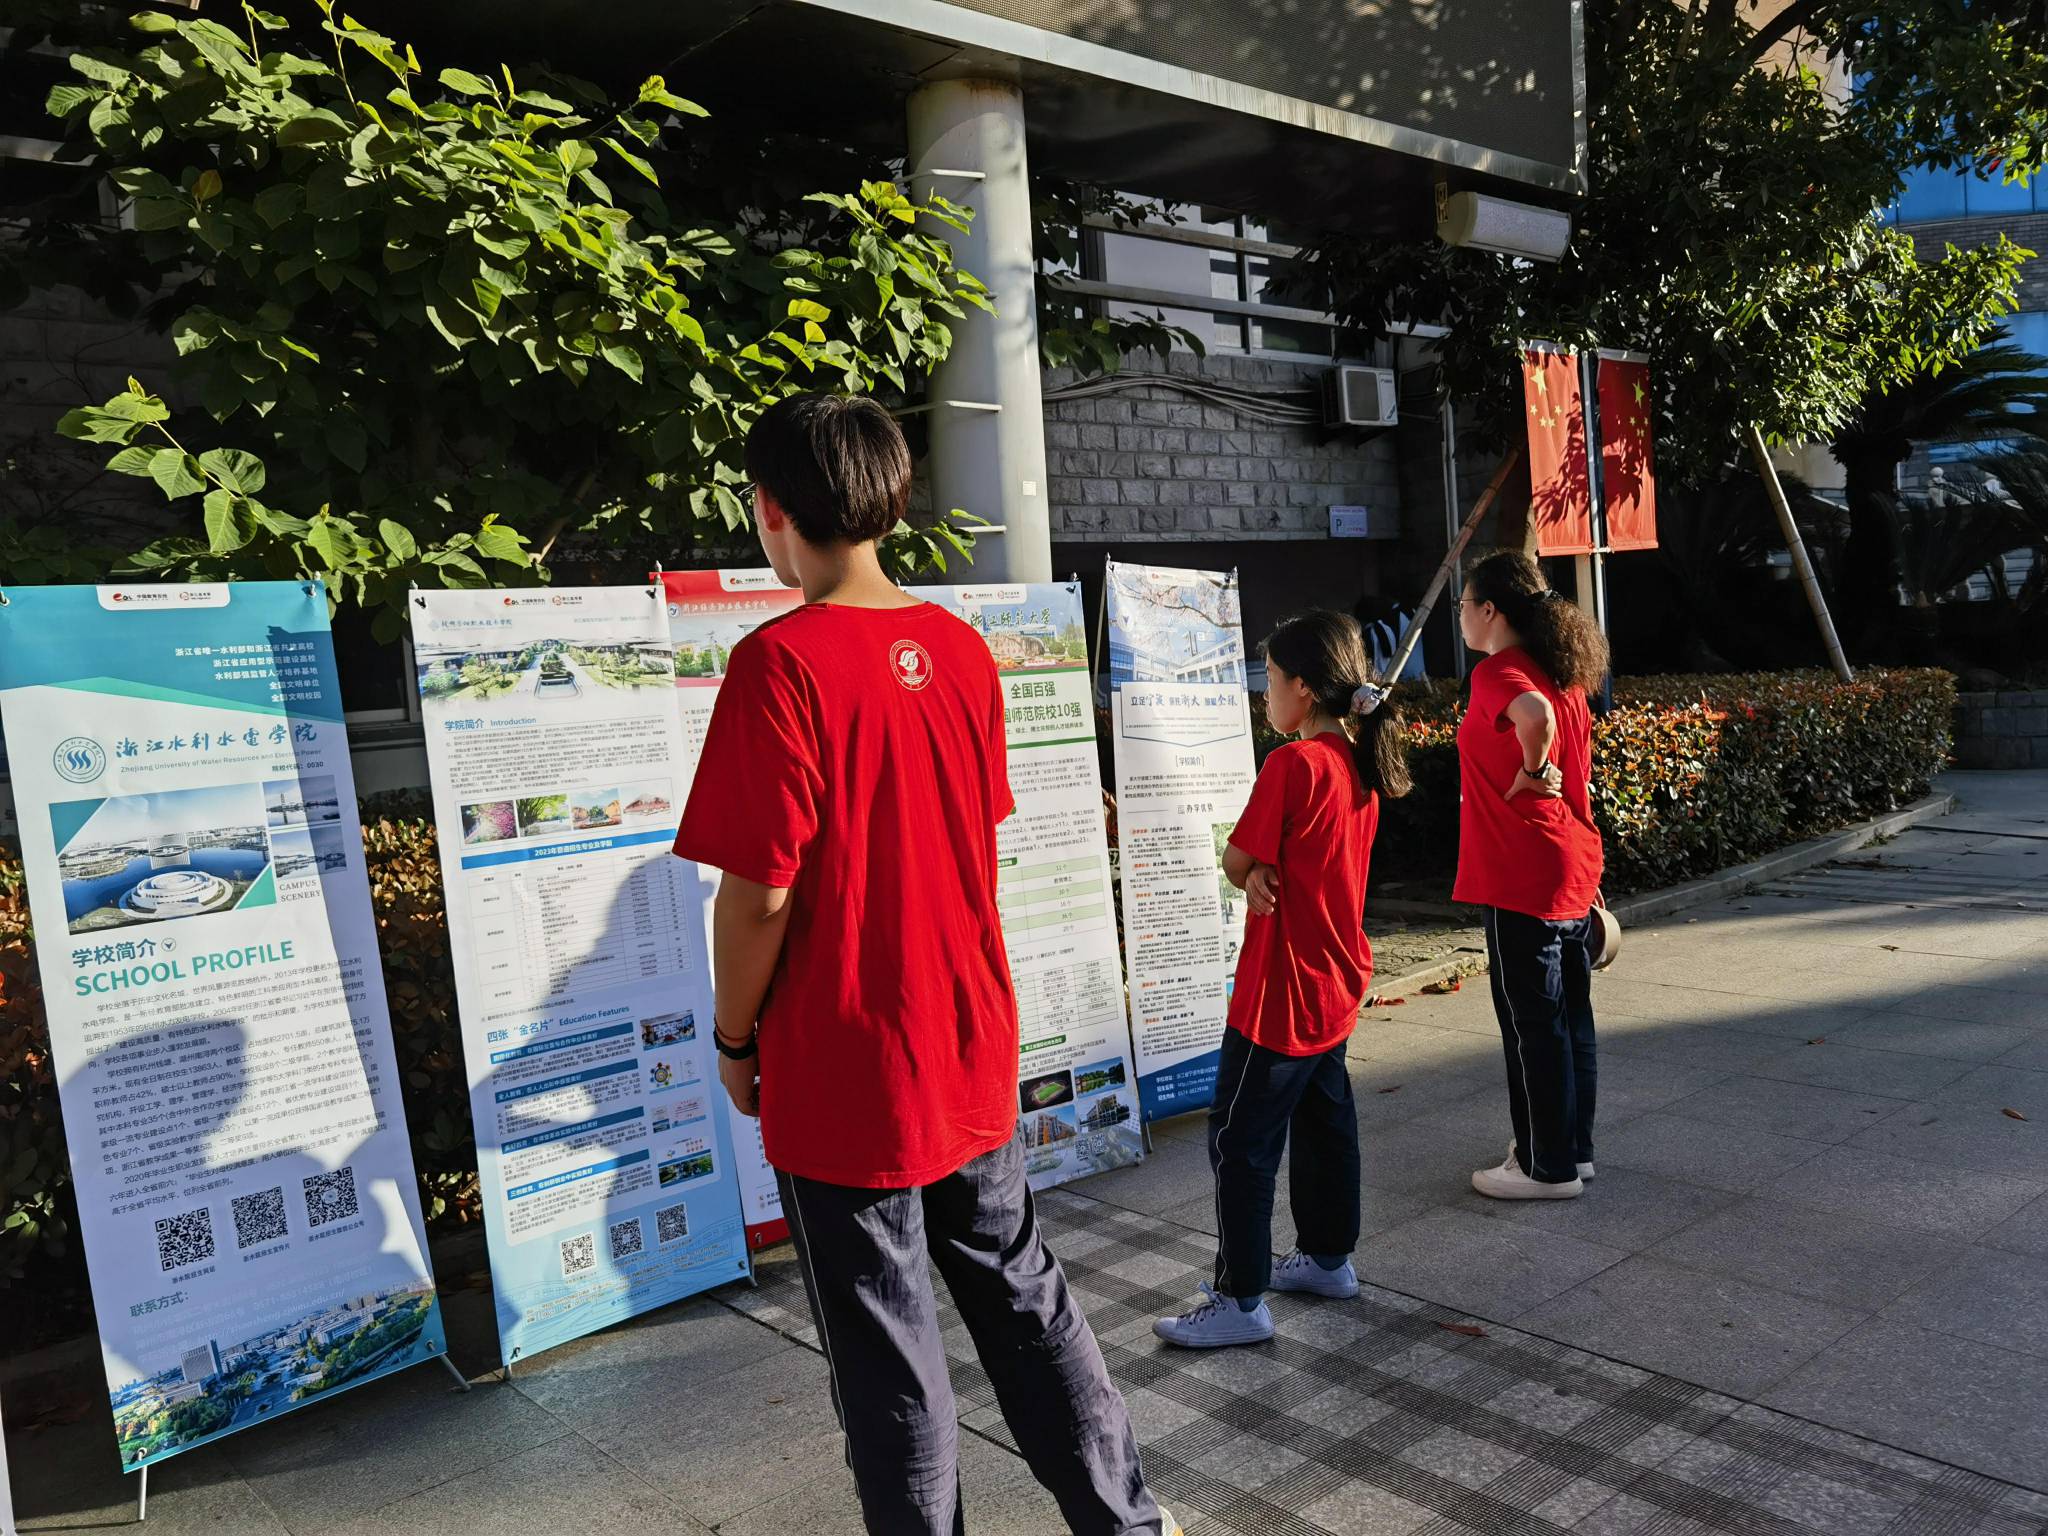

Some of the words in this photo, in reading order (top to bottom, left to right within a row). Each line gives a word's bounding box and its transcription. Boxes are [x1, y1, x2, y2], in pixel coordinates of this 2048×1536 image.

[269, 678, 320, 690] 全国文明单位
[1010, 680, 1057, 699] 全国百强
[271, 691, 322, 702] 全国文明校园
[444, 718, 484, 731] 学院简介
[490, 717, 537, 727] Introduction
[119, 763, 153, 774] Zhejiang
[154, 759, 190, 771] University
[190, 758, 199, 767] of
[200, 756, 222, 766] Water
[223, 752, 258, 764] Resources
[259, 751, 273, 760] and
[300, 746, 321, 755] Power
[280, 879, 317, 892] CAMPUS
[281, 890, 321, 903] SCENERY
[71, 938, 157, 969] 学校简介
[74, 959, 187, 997] SCHOOL
[192, 940, 296, 978] PROFILE
[559, 1011, 597, 1027] Education
[598, 1005, 630, 1020] Features
